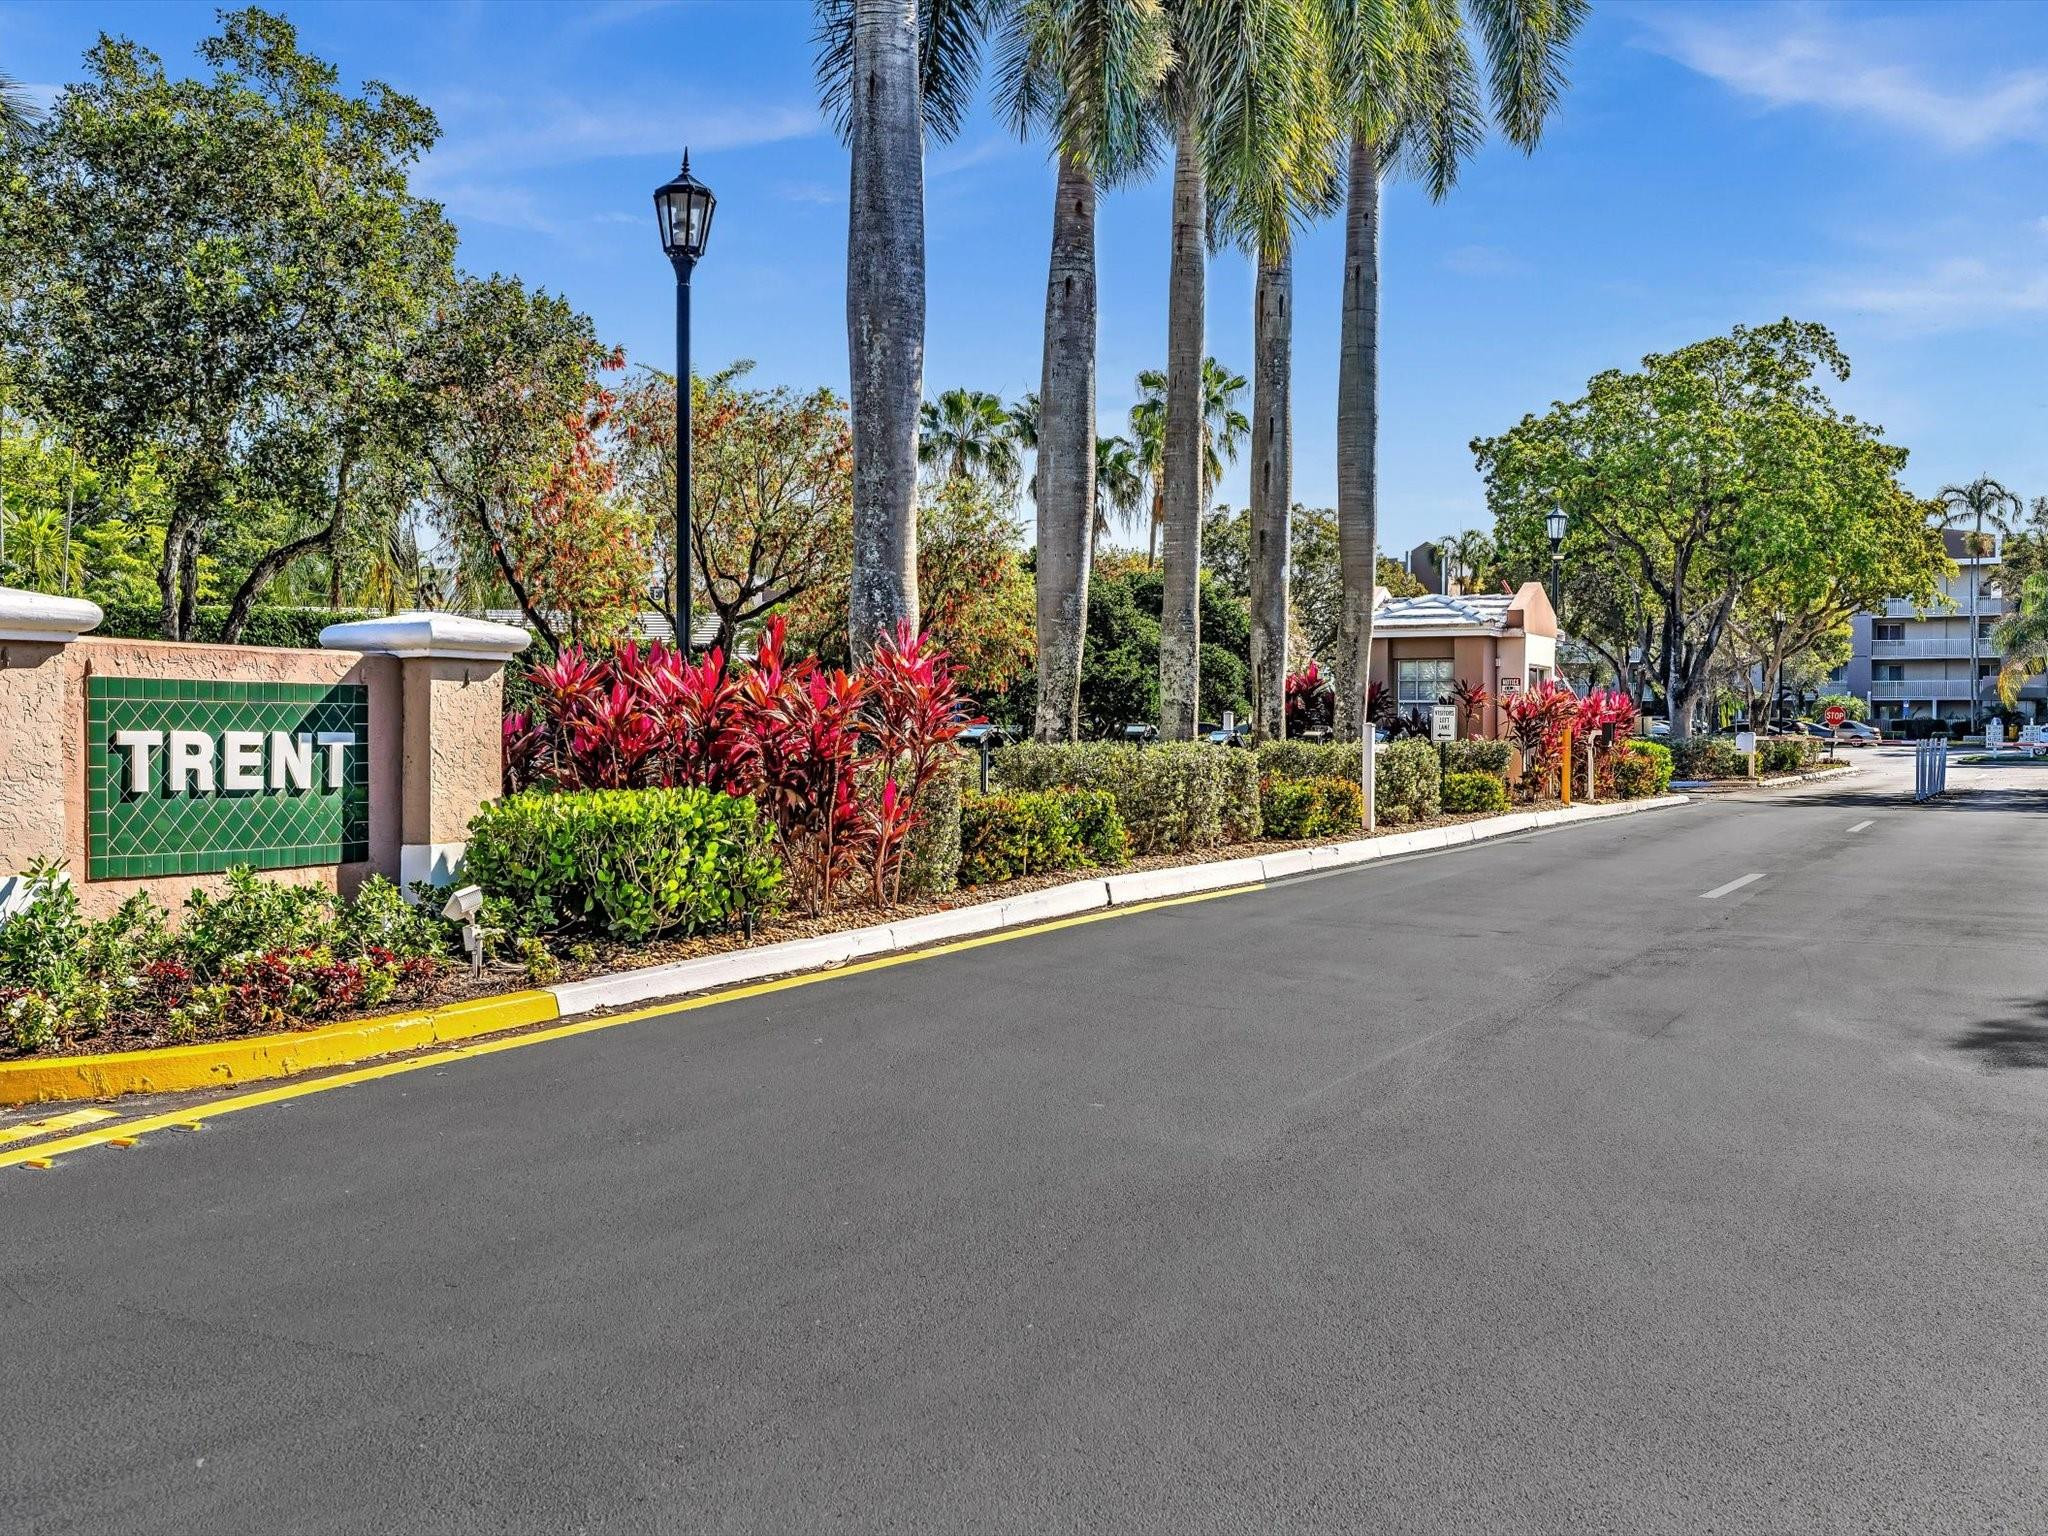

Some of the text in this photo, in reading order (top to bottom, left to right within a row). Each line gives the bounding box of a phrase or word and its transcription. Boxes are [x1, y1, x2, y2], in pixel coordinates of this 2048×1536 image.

[1502, 678, 1520, 686] NOTICE
[1826, 712, 1844, 720] STOP
[116, 730, 355, 793] TRENT
